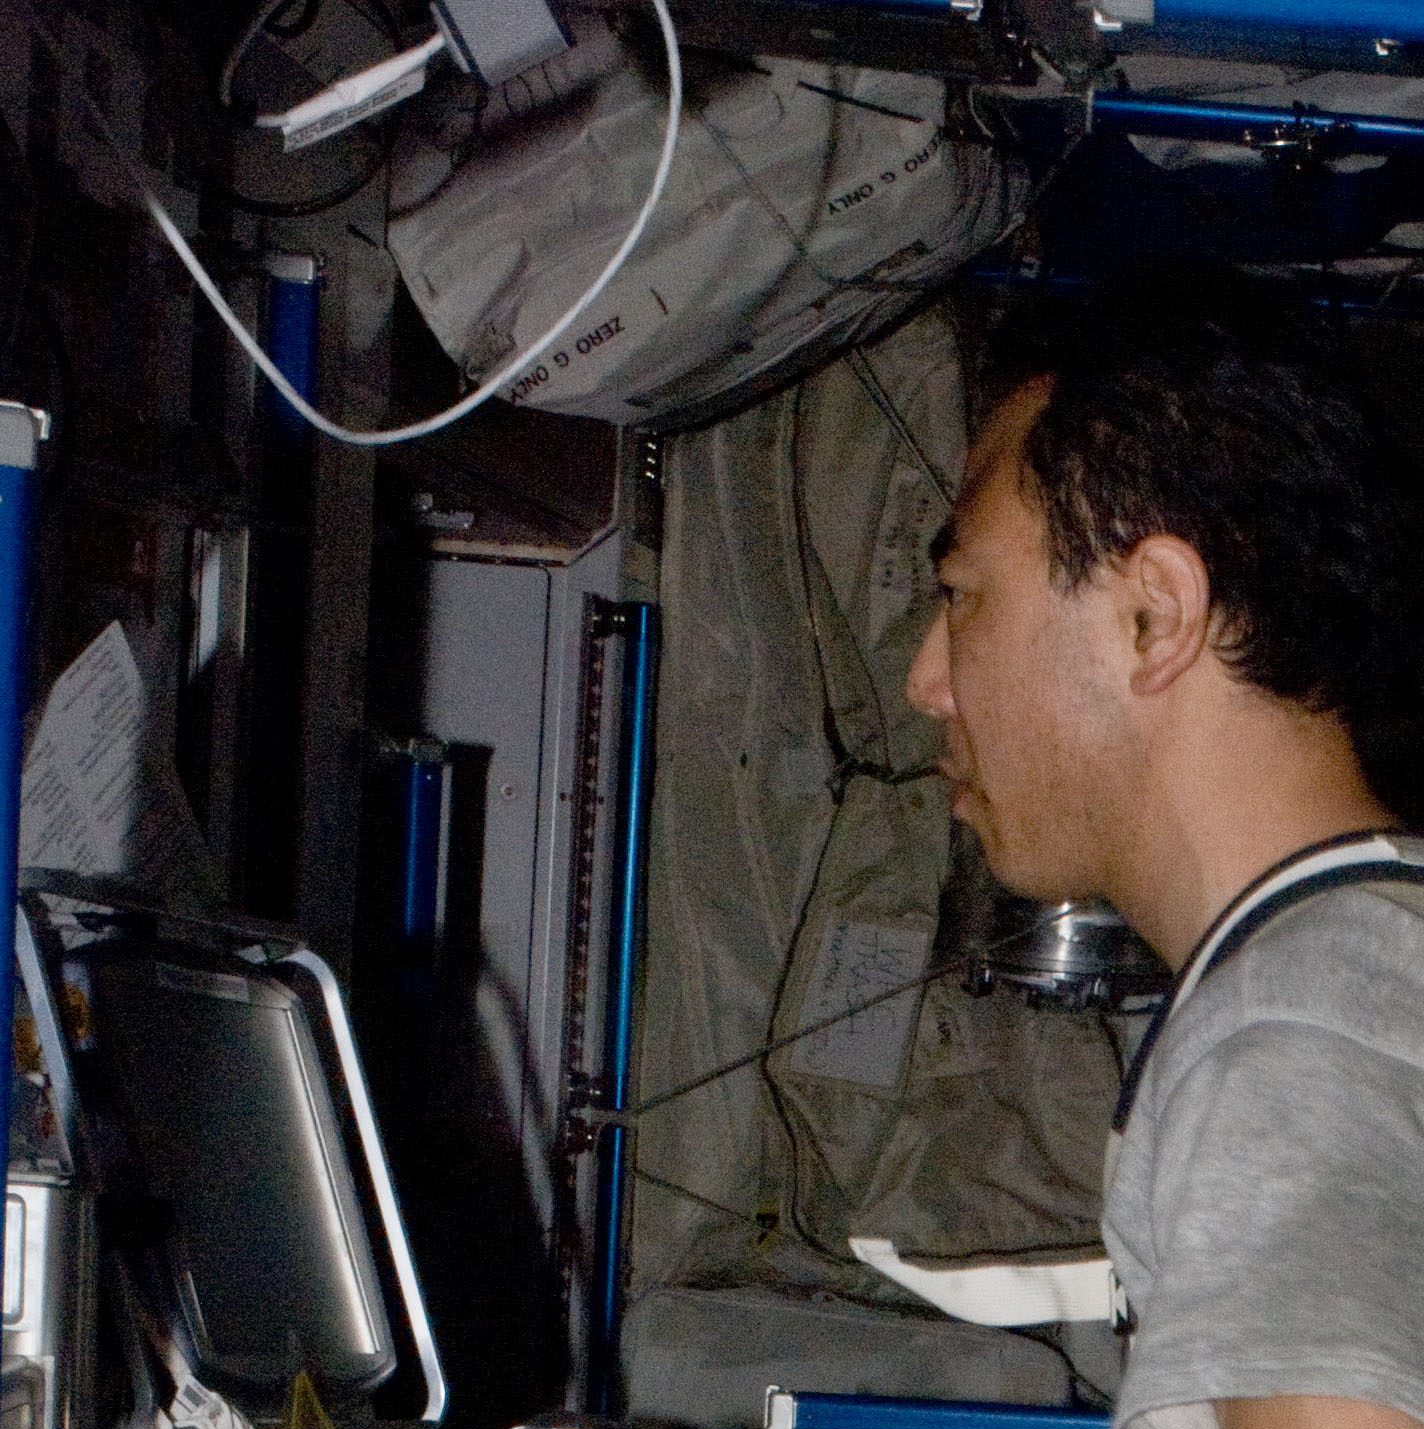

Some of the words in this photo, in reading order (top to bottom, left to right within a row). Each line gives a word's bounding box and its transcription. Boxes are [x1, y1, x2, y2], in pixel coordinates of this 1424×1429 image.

[905, 130, 943, 173] ERO
[880, 171, 896, 185] G
[827, 184, 874, 215] ONLY
[575, 316, 626, 354] ZERO
[553, 351, 570, 368] G
[511, 365, 550, 404] ONLY
